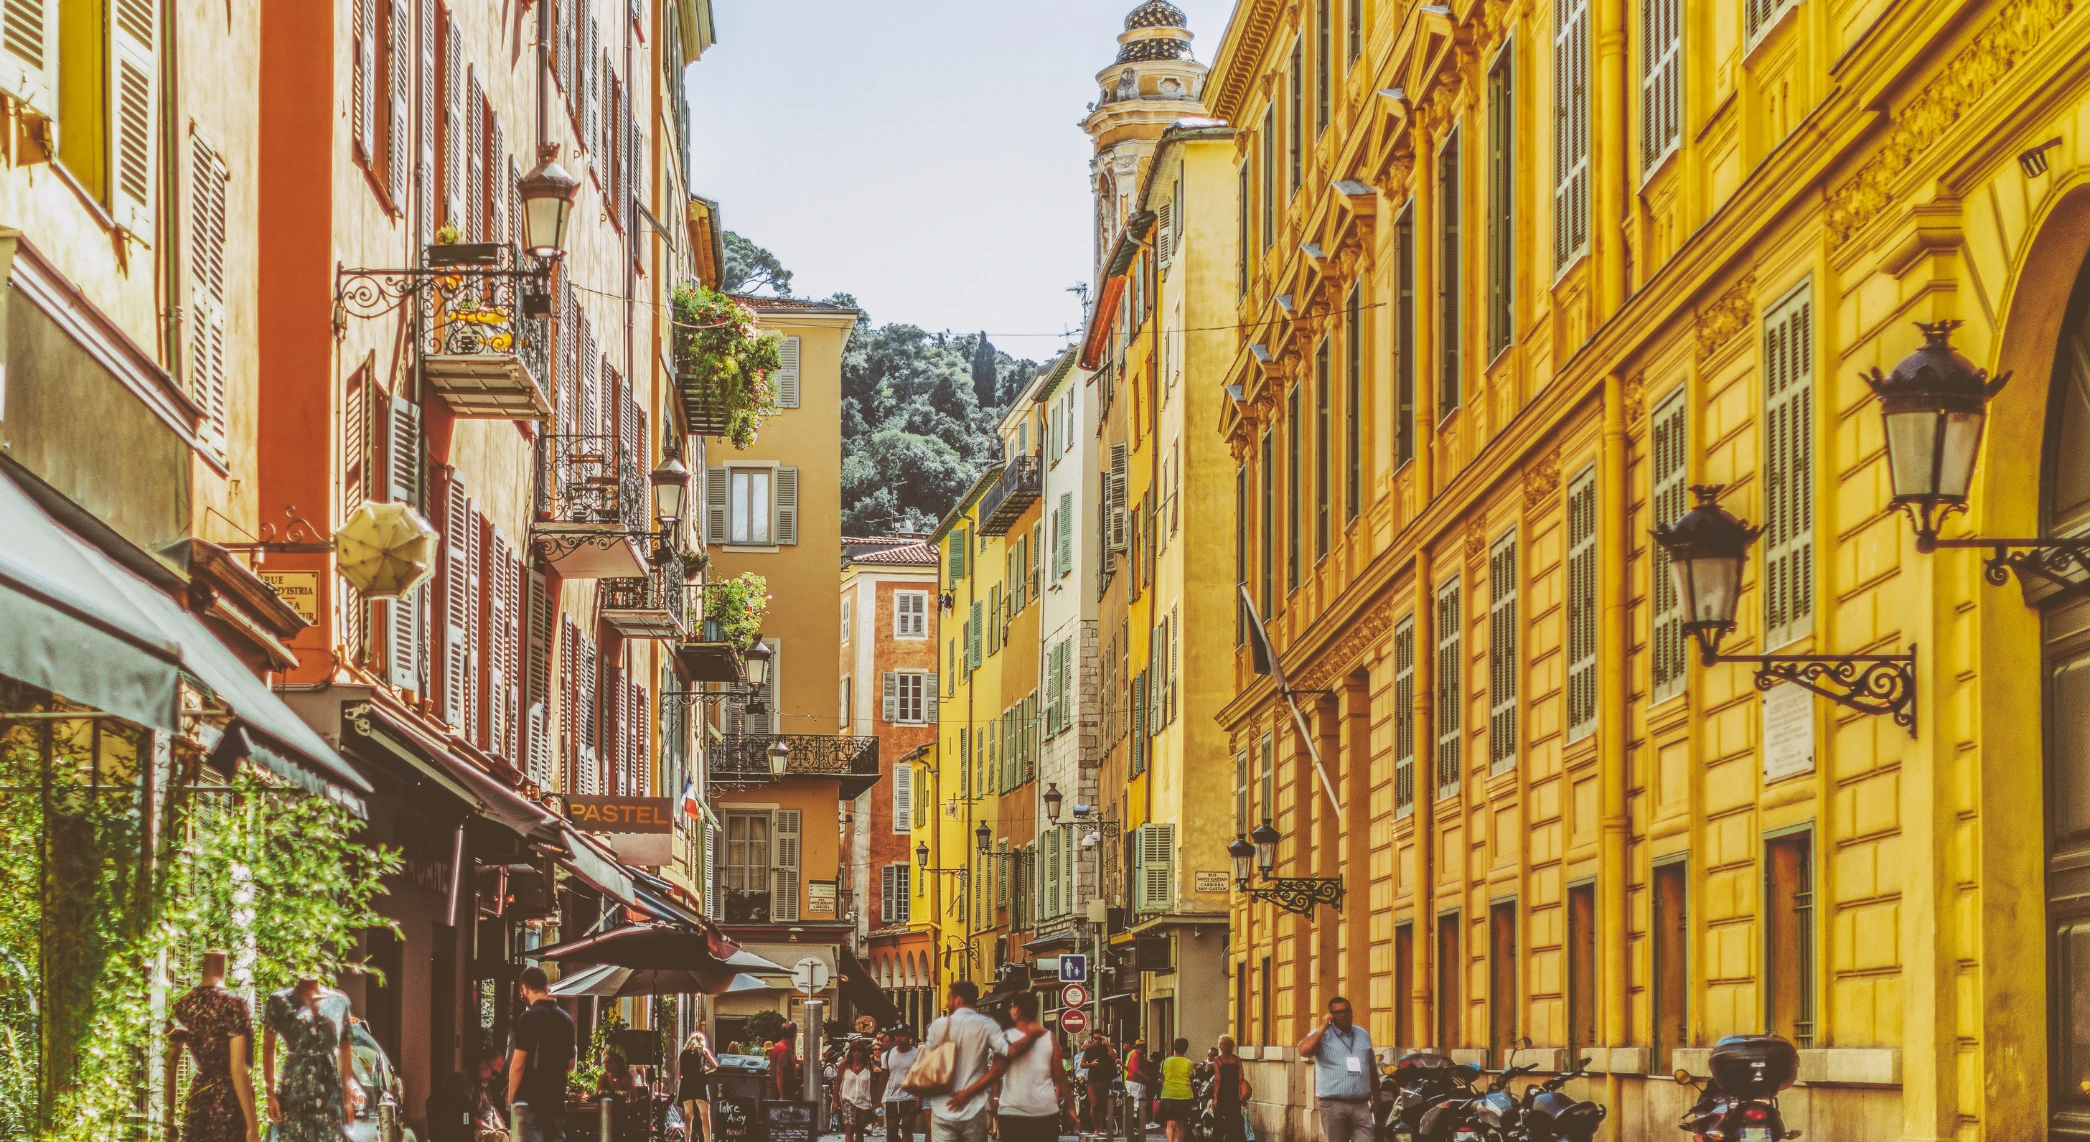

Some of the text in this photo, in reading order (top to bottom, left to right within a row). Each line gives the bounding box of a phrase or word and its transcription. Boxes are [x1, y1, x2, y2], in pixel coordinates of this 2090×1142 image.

[264, 576, 284, 584] RUE
[278, 586, 313, 595] D'ISTRIA
[570, 803, 668, 825] PASTEL
[715, 1100, 740, 1113] Take
